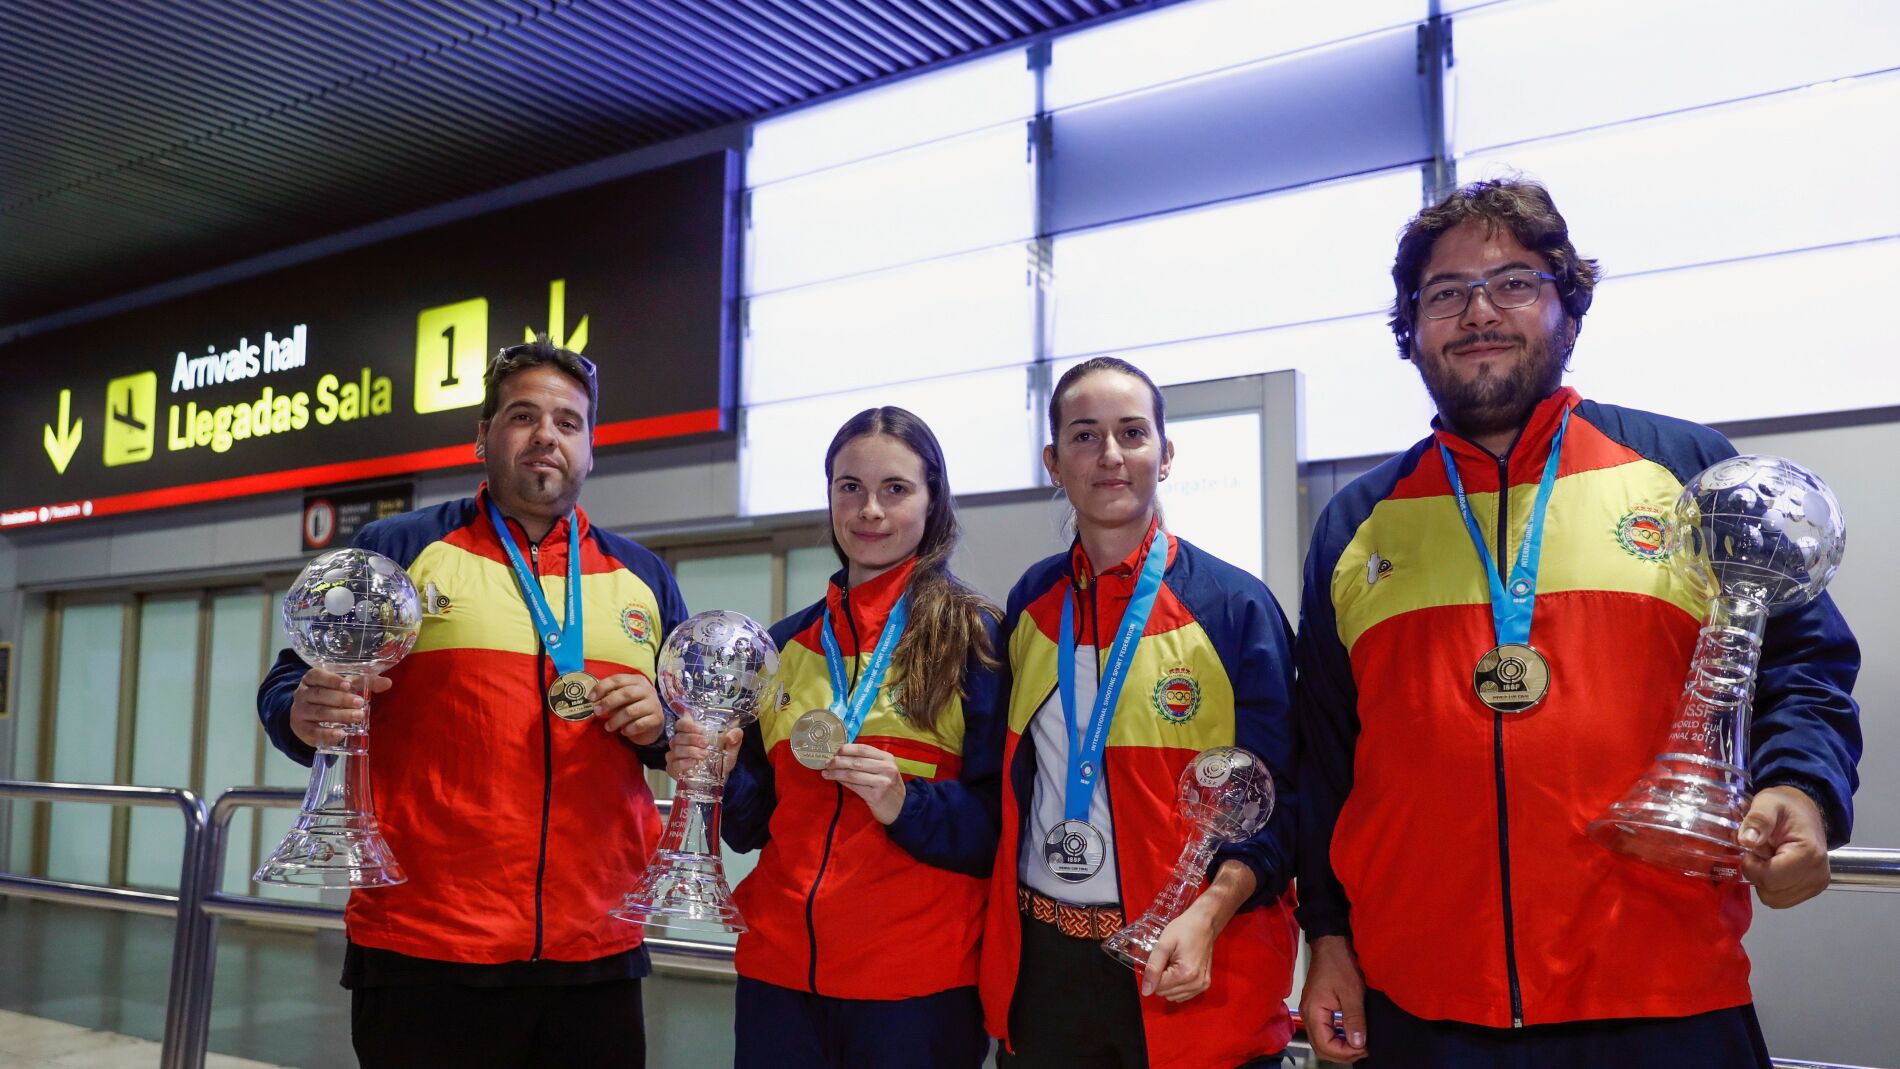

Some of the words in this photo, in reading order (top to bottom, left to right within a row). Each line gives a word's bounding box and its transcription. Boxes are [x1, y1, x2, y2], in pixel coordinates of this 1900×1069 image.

[171, 337, 260, 393] Arrivals
[263, 324, 307, 374] hall
[441, 325, 459, 388] 1
[168, 386, 309, 453] Llegadas
[315, 367, 392, 425] Sala
[1091, 707, 1107, 751] INTERNATIONAL
[1103, 677, 1116, 706] SHOOTING
[1112, 660, 1122, 677] SPORT
[1121, 623, 1136, 658] FEDERATION
